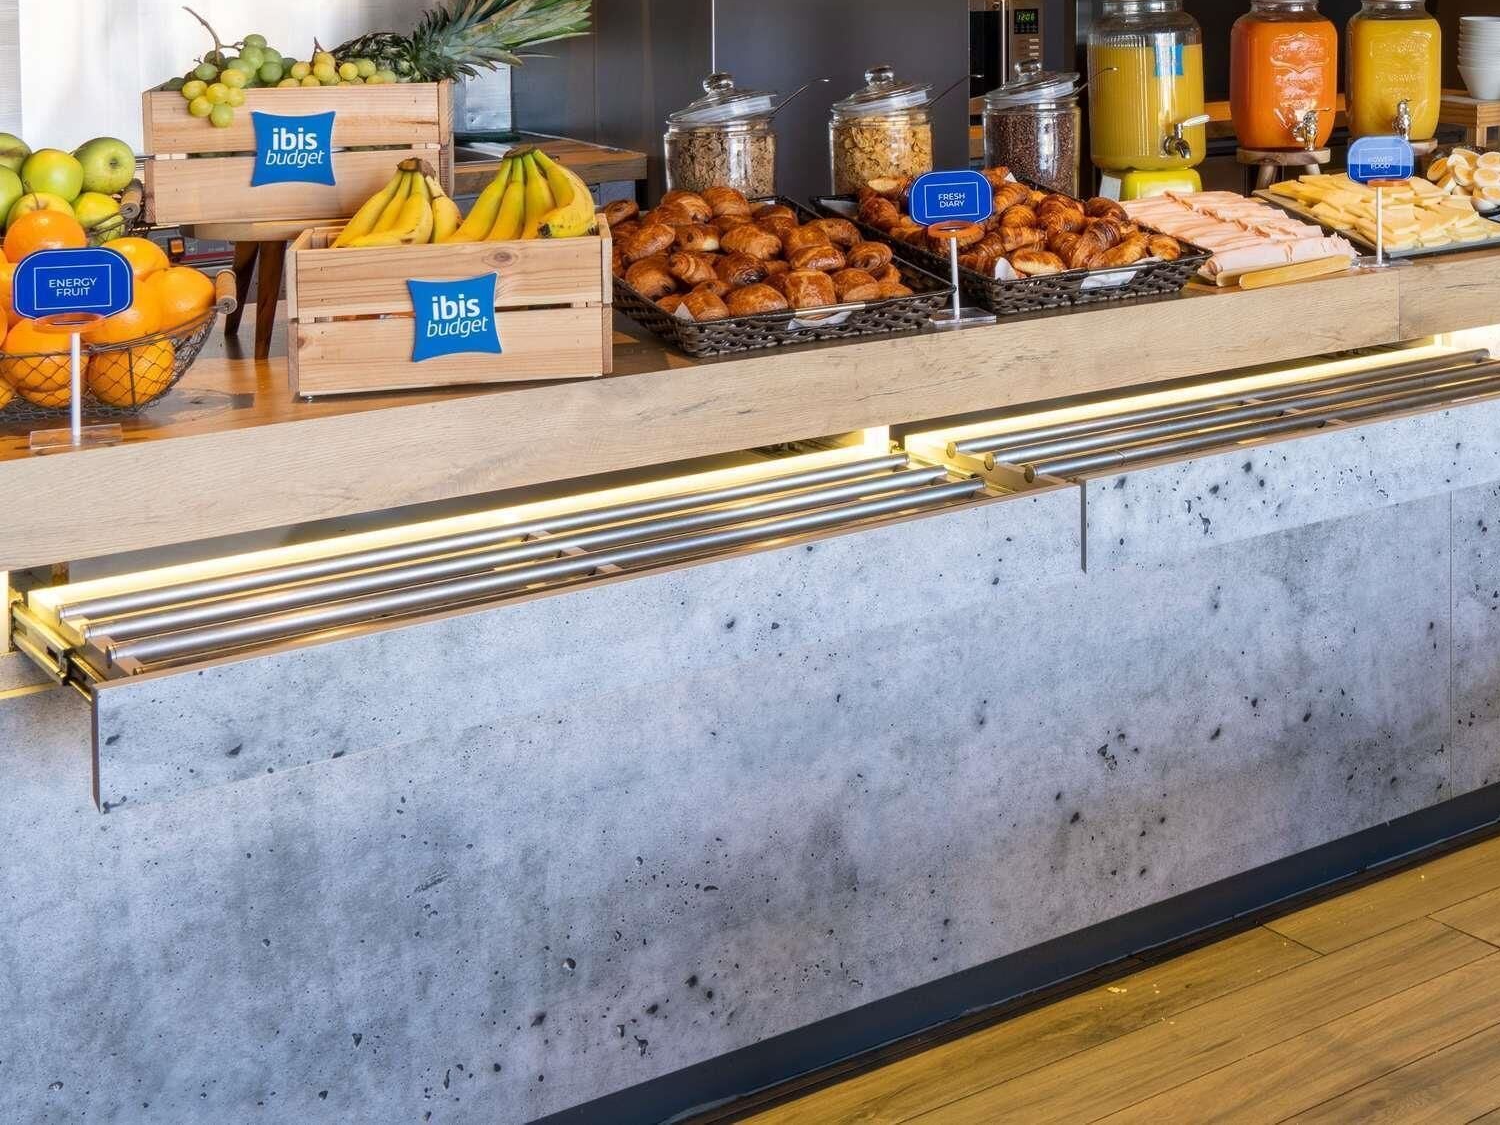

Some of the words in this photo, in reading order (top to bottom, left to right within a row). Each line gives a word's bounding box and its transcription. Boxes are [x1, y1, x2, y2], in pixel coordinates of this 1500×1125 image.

[272, 127, 318, 150] ibis
[265, 149, 325, 168] budget
[1370, 162, 1392, 170] FOOD
[938, 192, 966, 201] FRESH
[939, 200, 965, 208] DIARY
[48, 277, 98, 288] ENERGY
[56, 286, 91, 297] FRUIT
[431, 293, 481, 321] ibis
[426, 316, 489, 338] budget
